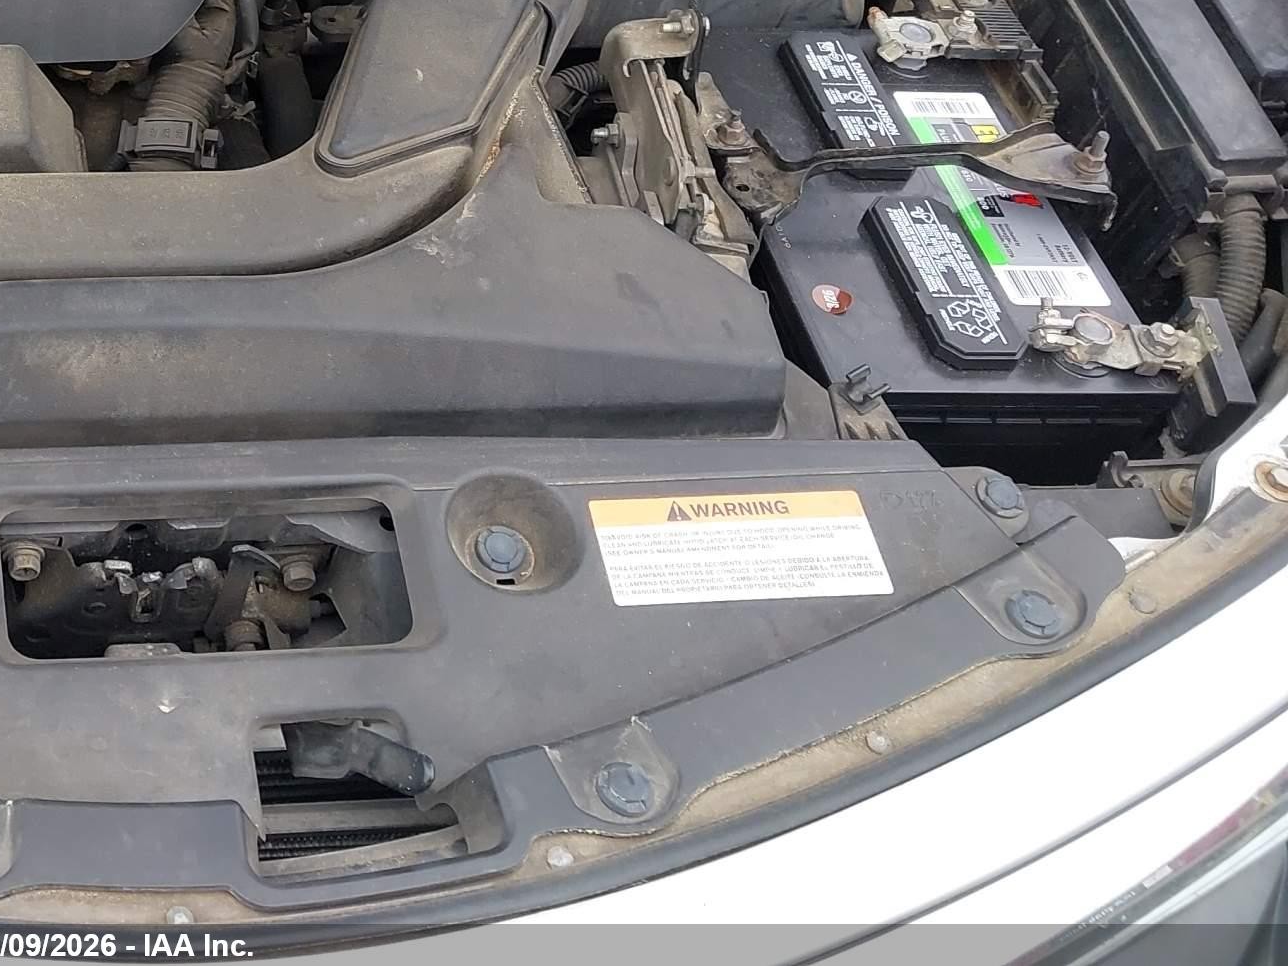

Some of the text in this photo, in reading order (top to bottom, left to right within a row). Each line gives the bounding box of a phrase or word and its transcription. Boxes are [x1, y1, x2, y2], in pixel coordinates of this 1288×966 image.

[851, 62, 878, 97] DANGER
[874, 103, 901, 136] POISON
[689, 499, 791, 518] WARNING
